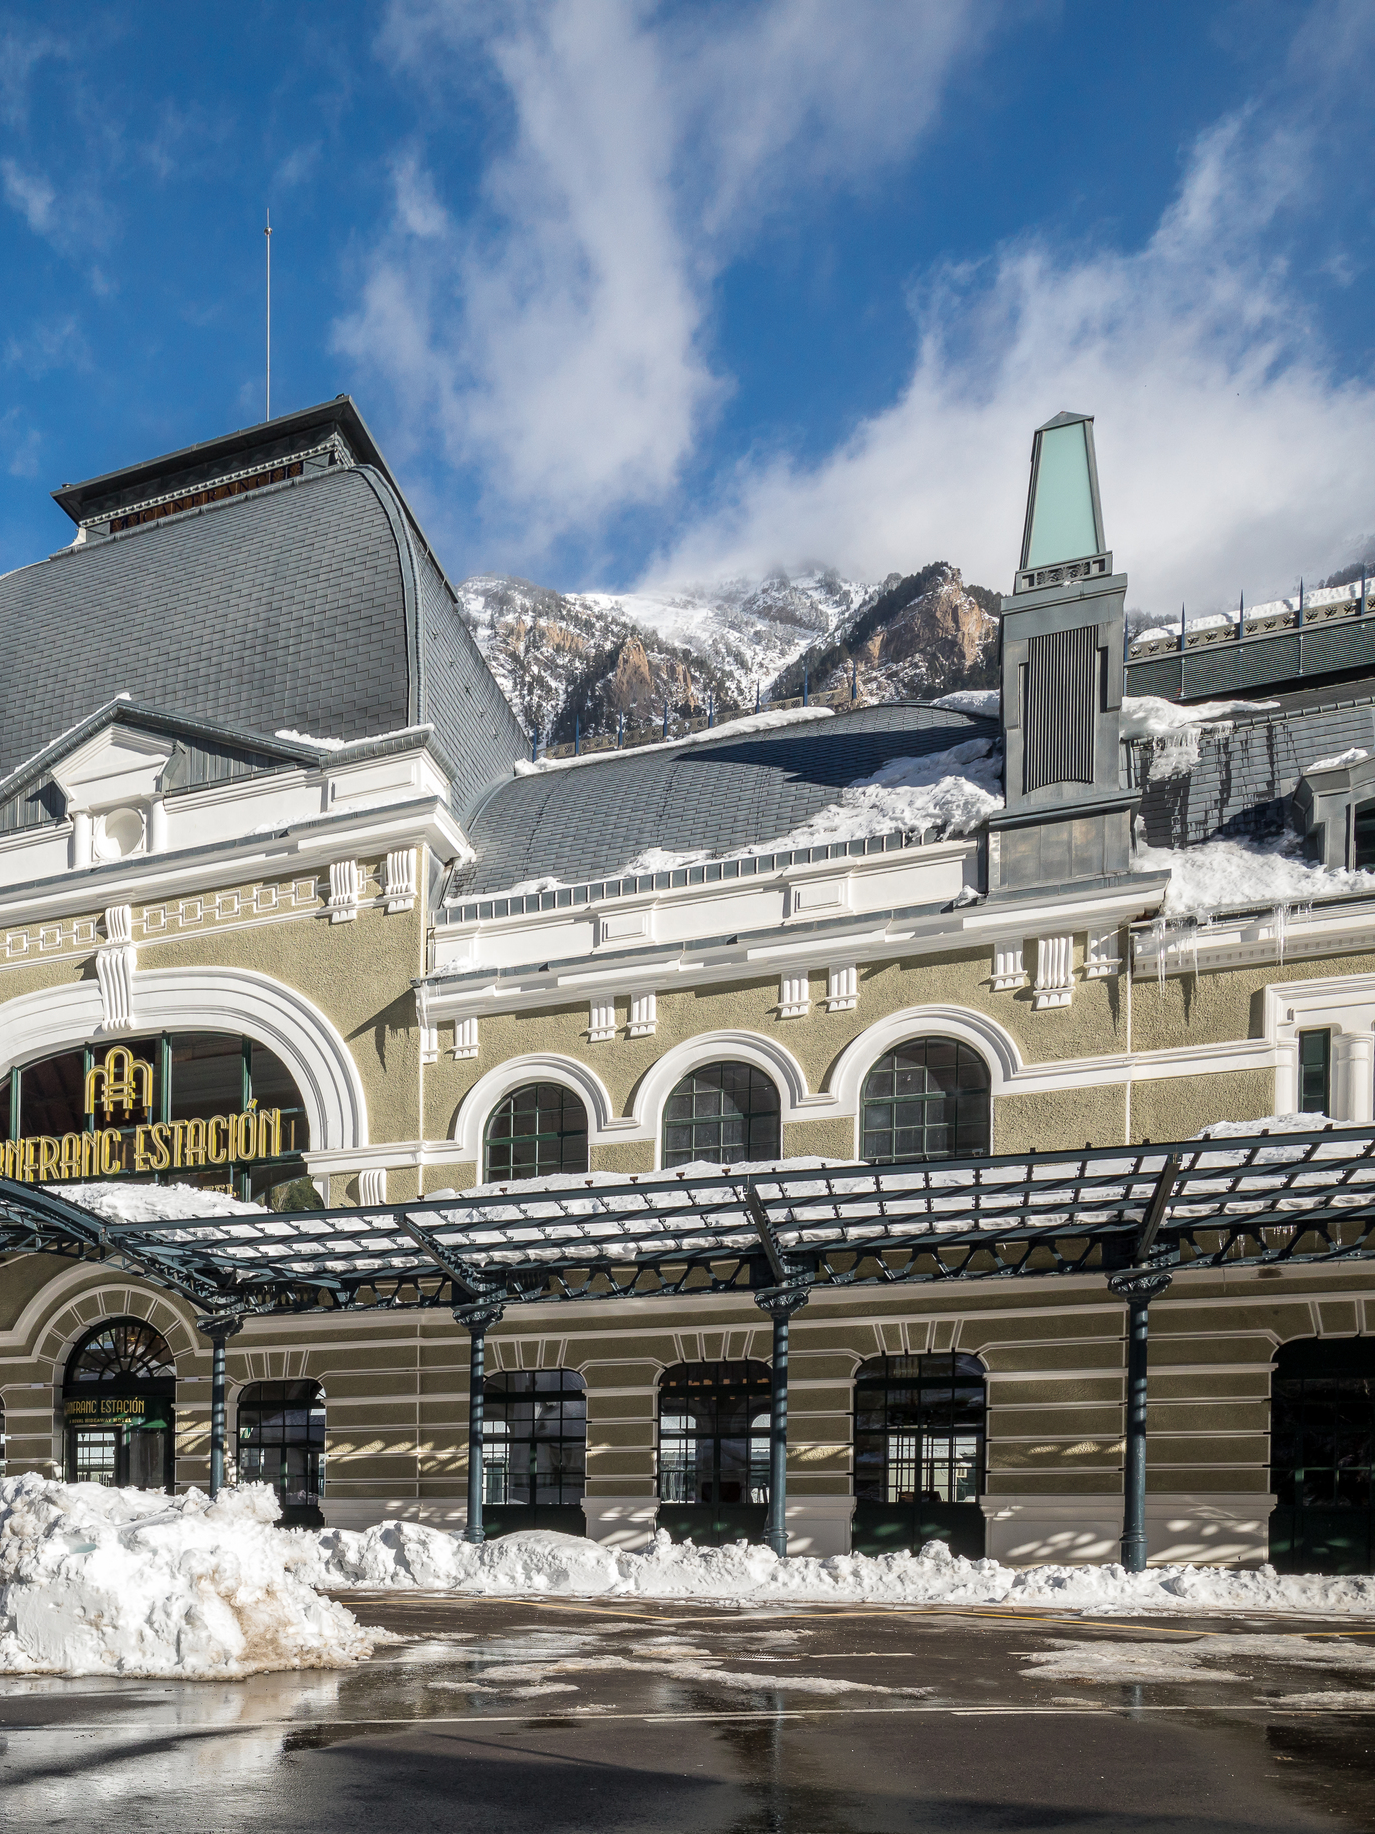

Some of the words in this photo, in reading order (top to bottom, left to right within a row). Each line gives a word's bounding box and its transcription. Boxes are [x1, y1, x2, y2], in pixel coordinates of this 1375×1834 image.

[134, 1098, 281, 1171] ESTACIÓN
[65, 1400, 97, 1414] ANFRANC
[100, 1397, 145, 1413] ESTACIÓN
